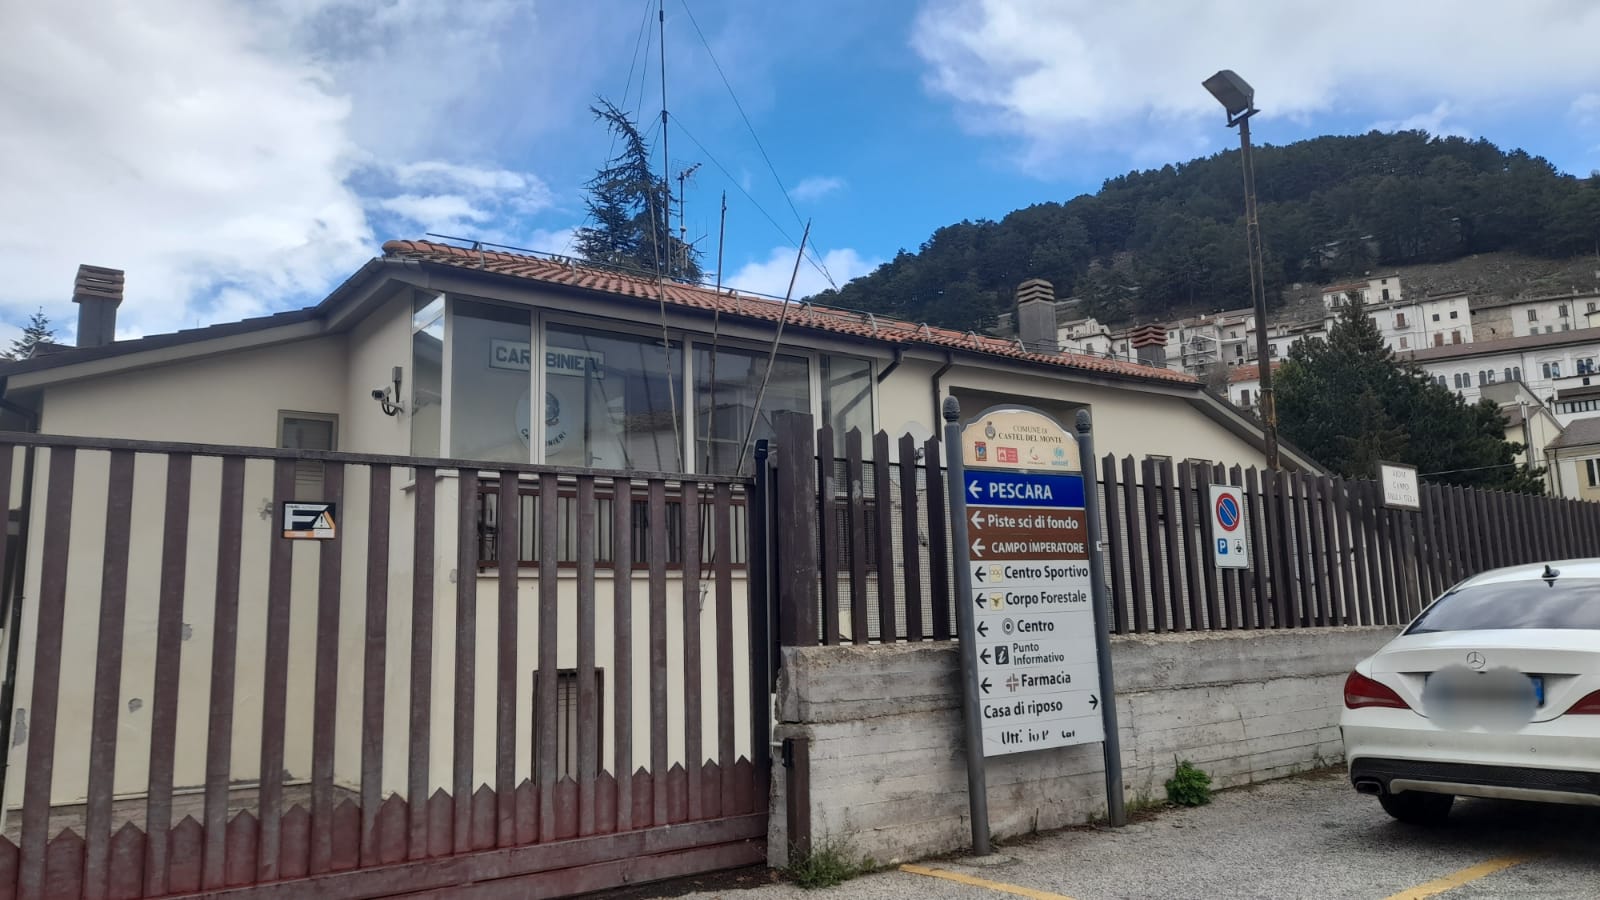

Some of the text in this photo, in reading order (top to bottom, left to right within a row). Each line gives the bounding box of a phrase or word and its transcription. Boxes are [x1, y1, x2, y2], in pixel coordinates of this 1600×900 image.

[998, 431, 1063, 444] CASTEL DEL MONTE
[989, 482, 1053, 500] PESCARA
[987, 514, 1079, 529] Piste sci di fondo
[991, 541, 1085, 554] CAMPO IMPERATORE
[1004, 564, 1089, 581] Centro Sportivo
[1005, 589, 1087, 608] Corpo Forestale
[1017, 619, 1055, 633] Centro
[1013, 642, 1040, 653] Punto
[1013, 652, 1065, 666] Informativo
[1021, 671, 1071, 687] Farmacia
[984, 700, 1063, 719] Casa di riposo
